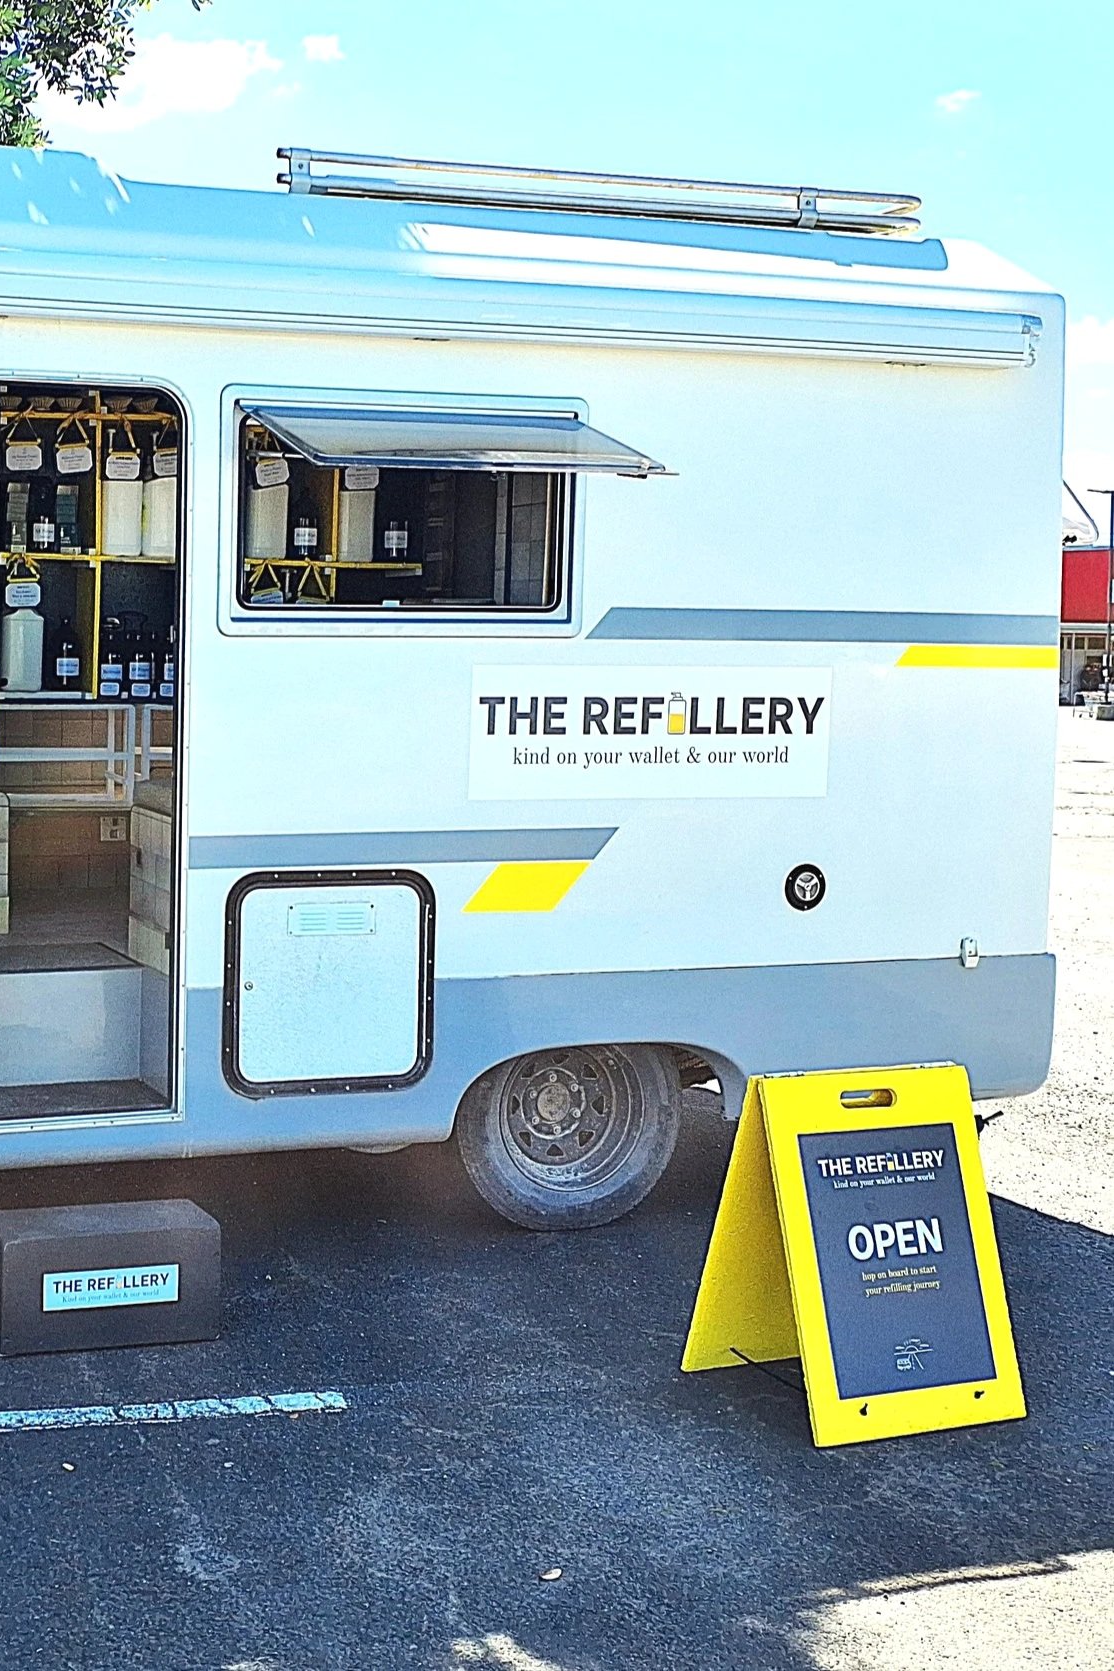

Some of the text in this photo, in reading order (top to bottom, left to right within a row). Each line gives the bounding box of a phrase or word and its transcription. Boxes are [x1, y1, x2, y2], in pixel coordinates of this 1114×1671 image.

[479, 696, 568, 736] THE
[513, 746, 789, 769] kind on your wallet & our world
[817, 1157, 854, 1178] THE
[833, 1180, 849, 1189] kind
[859, 1179, 874, 1189] your
[876, 1175, 896, 1185] wallet
[897, 1175, 903, 1184] &
[904, 1175, 916, 1183] our
[917, 1172, 936, 1182] world
[848, 1218, 944, 1261] OPEN
[862, 1265, 937, 1282] hop on board to start
[53, 1279, 83, 1294] THE
[865, 1280, 941, 1298] your refilling journey
